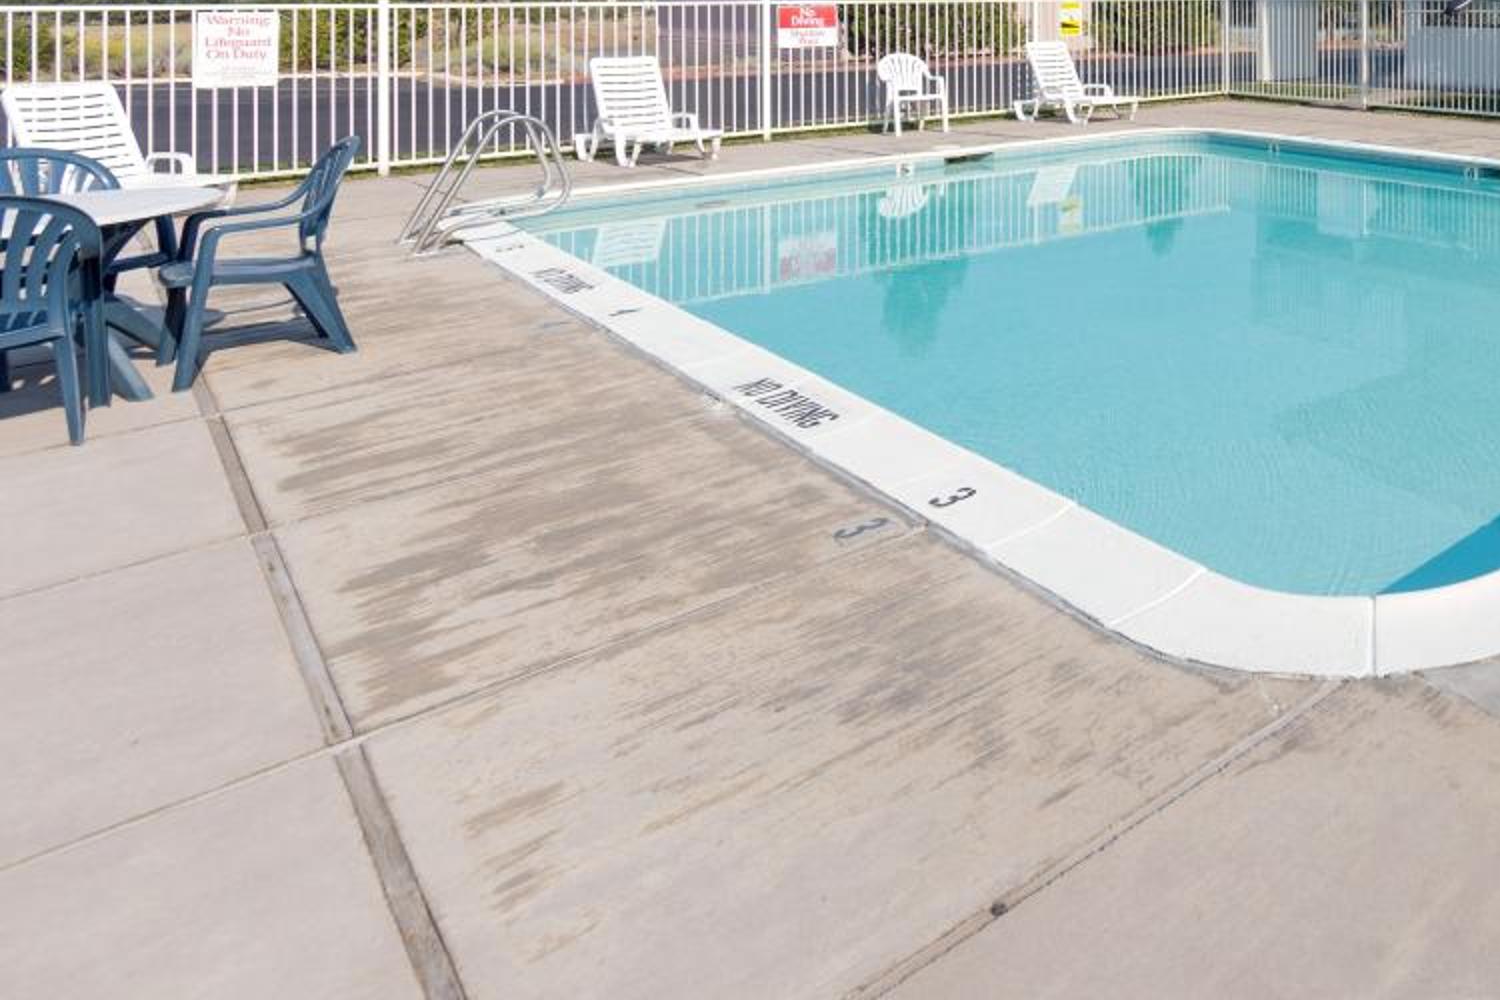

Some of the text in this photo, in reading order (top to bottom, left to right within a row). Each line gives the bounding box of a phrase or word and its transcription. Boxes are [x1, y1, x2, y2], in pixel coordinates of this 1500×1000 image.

[227, 27, 250, 37] No
[205, 36, 272, 50] Lifeguard
[206, 48, 267, 61] On Duty
[732, 377, 840, 429] NO DIVING
[928, 486, 977, 508] 3
